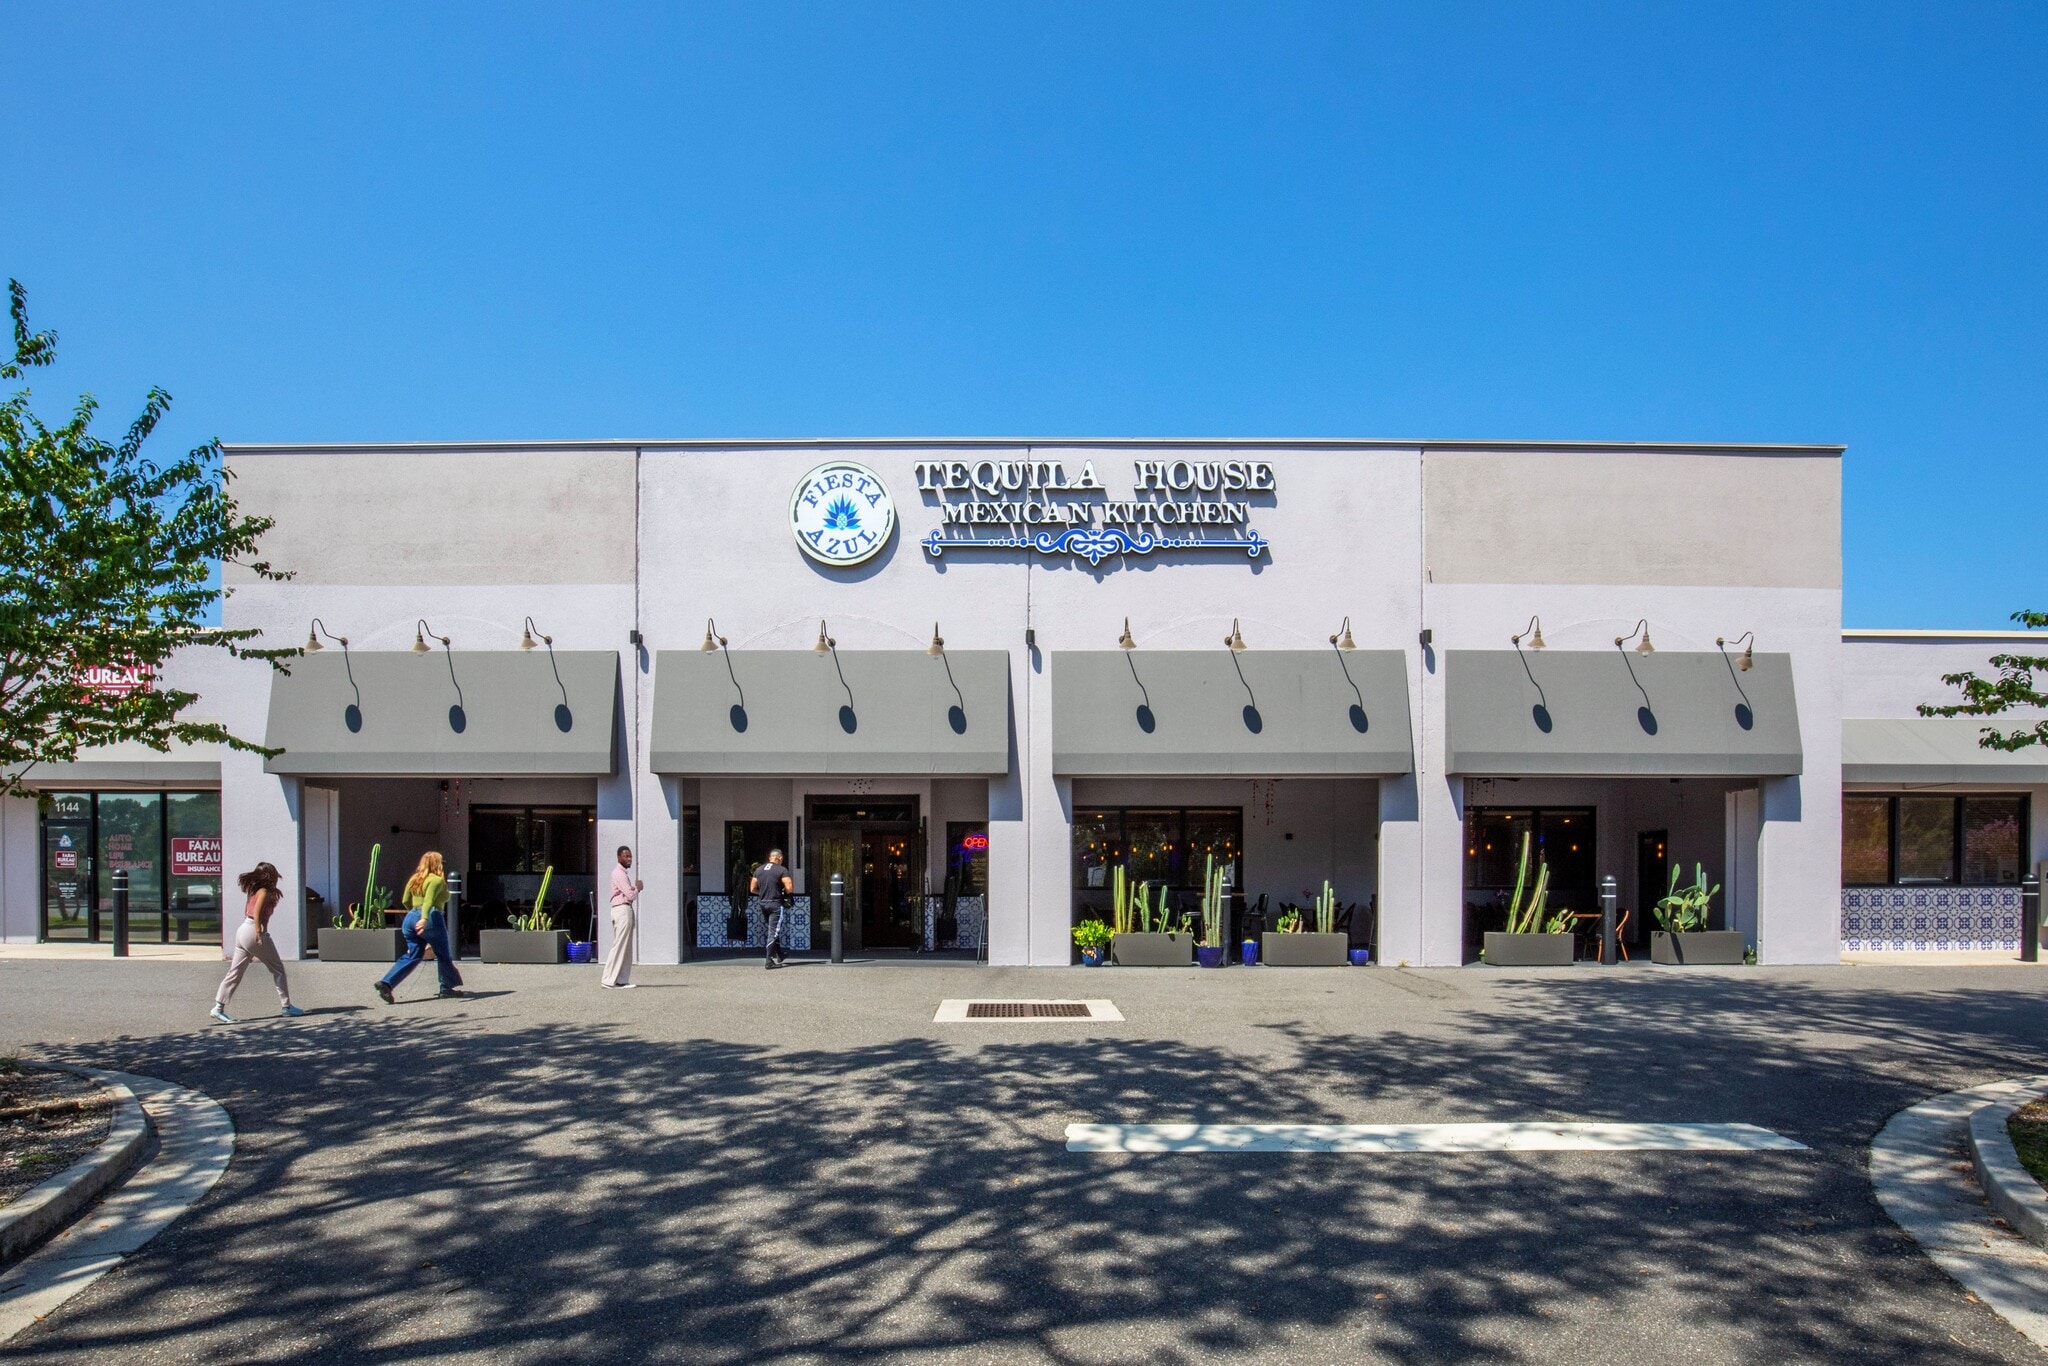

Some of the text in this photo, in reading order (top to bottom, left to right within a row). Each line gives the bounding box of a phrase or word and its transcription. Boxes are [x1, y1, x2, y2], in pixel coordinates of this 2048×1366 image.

[914, 460, 1275, 496] TEQUILA HOUSE
[803, 473, 881, 508] FIESTA
[942, 501, 1247, 525] MEXICAN KITCHEN
[806, 529, 877, 555] AZUL
[55, 802, 79, 812] 1144
[109, 834, 132, 842] AUTO
[108, 843, 133, 851] HOME
[188, 840, 221, 851] FARM
[176, 852, 221, 862] BUREAU
